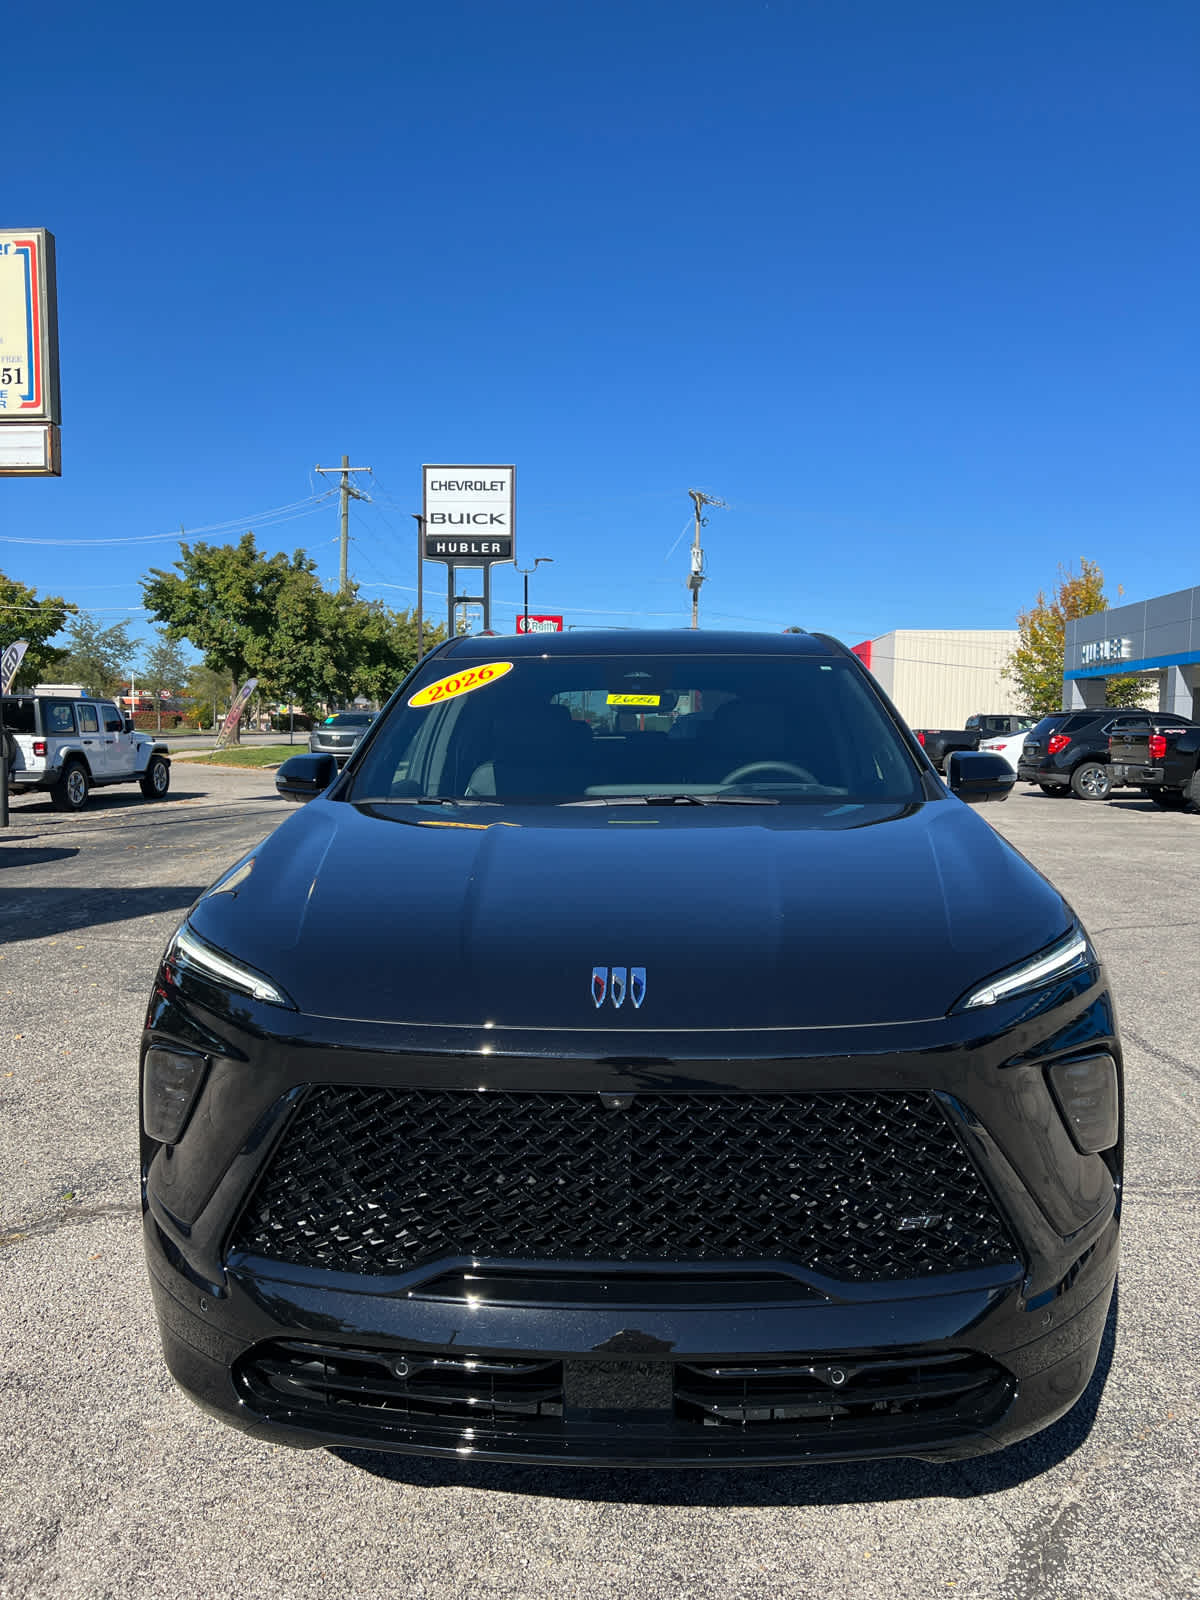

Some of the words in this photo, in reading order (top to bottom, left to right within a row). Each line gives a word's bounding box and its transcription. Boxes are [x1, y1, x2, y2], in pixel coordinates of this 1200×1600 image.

[1, 367, 23, 385] 51
[430, 480, 506, 492] CHEVROLET
[430, 512, 506, 525] BUICK
[436, 542, 501, 553] HUBLER
[428, 664, 495, 702] 2026
